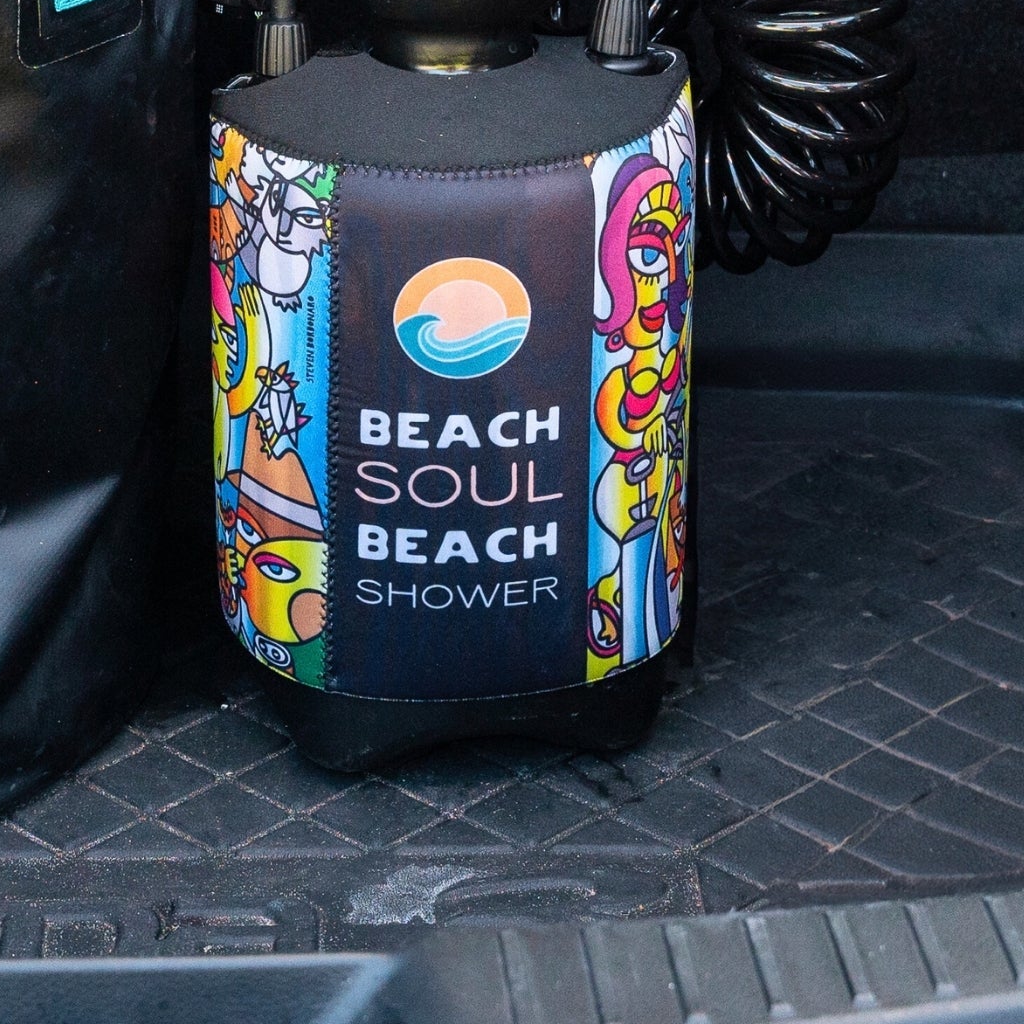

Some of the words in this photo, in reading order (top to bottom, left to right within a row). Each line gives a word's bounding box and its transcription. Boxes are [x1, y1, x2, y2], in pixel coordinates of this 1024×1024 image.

[306, 350, 315, 384] STEVEN
[360, 406, 559, 448] BEACH
[355, 461, 563, 507] SOUL
[358, 522, 557, 564] BEACH
[356, 577, 558, 609] SHOWER
